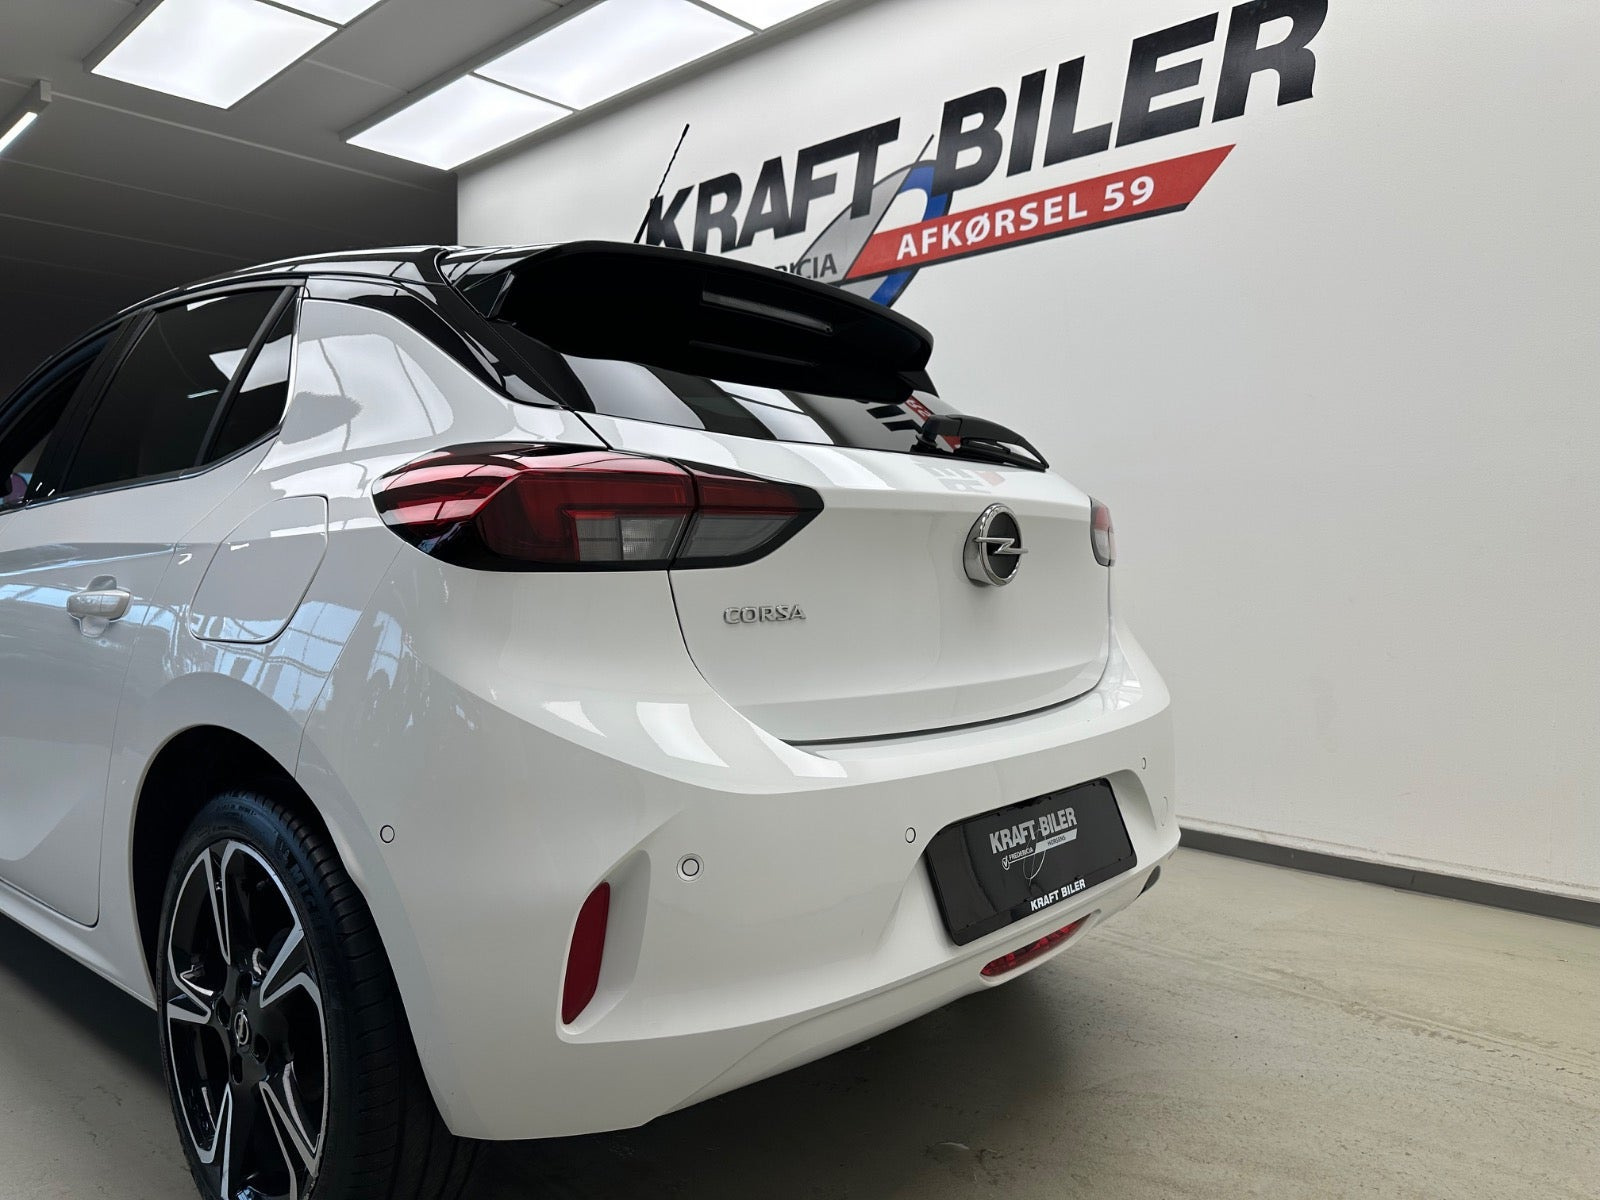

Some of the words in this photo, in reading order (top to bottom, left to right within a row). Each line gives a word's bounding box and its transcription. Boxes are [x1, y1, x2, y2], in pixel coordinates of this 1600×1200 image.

[646, 117, 901, 253] KRAFT
[931, 0, 1328, 196] BILER
[896, 198, 1087, 261] AFKØRSEL
[1103, 176, 1154, 212] 59
[723, 605, 807, 624] CORSA
[989, 820, 1036, 854] KRAFT
[1039, 807, 1077, 836] BILER
[1030, 890, 1060, 911] KRAFT
[1061, 879, 1086, 898] BILER
